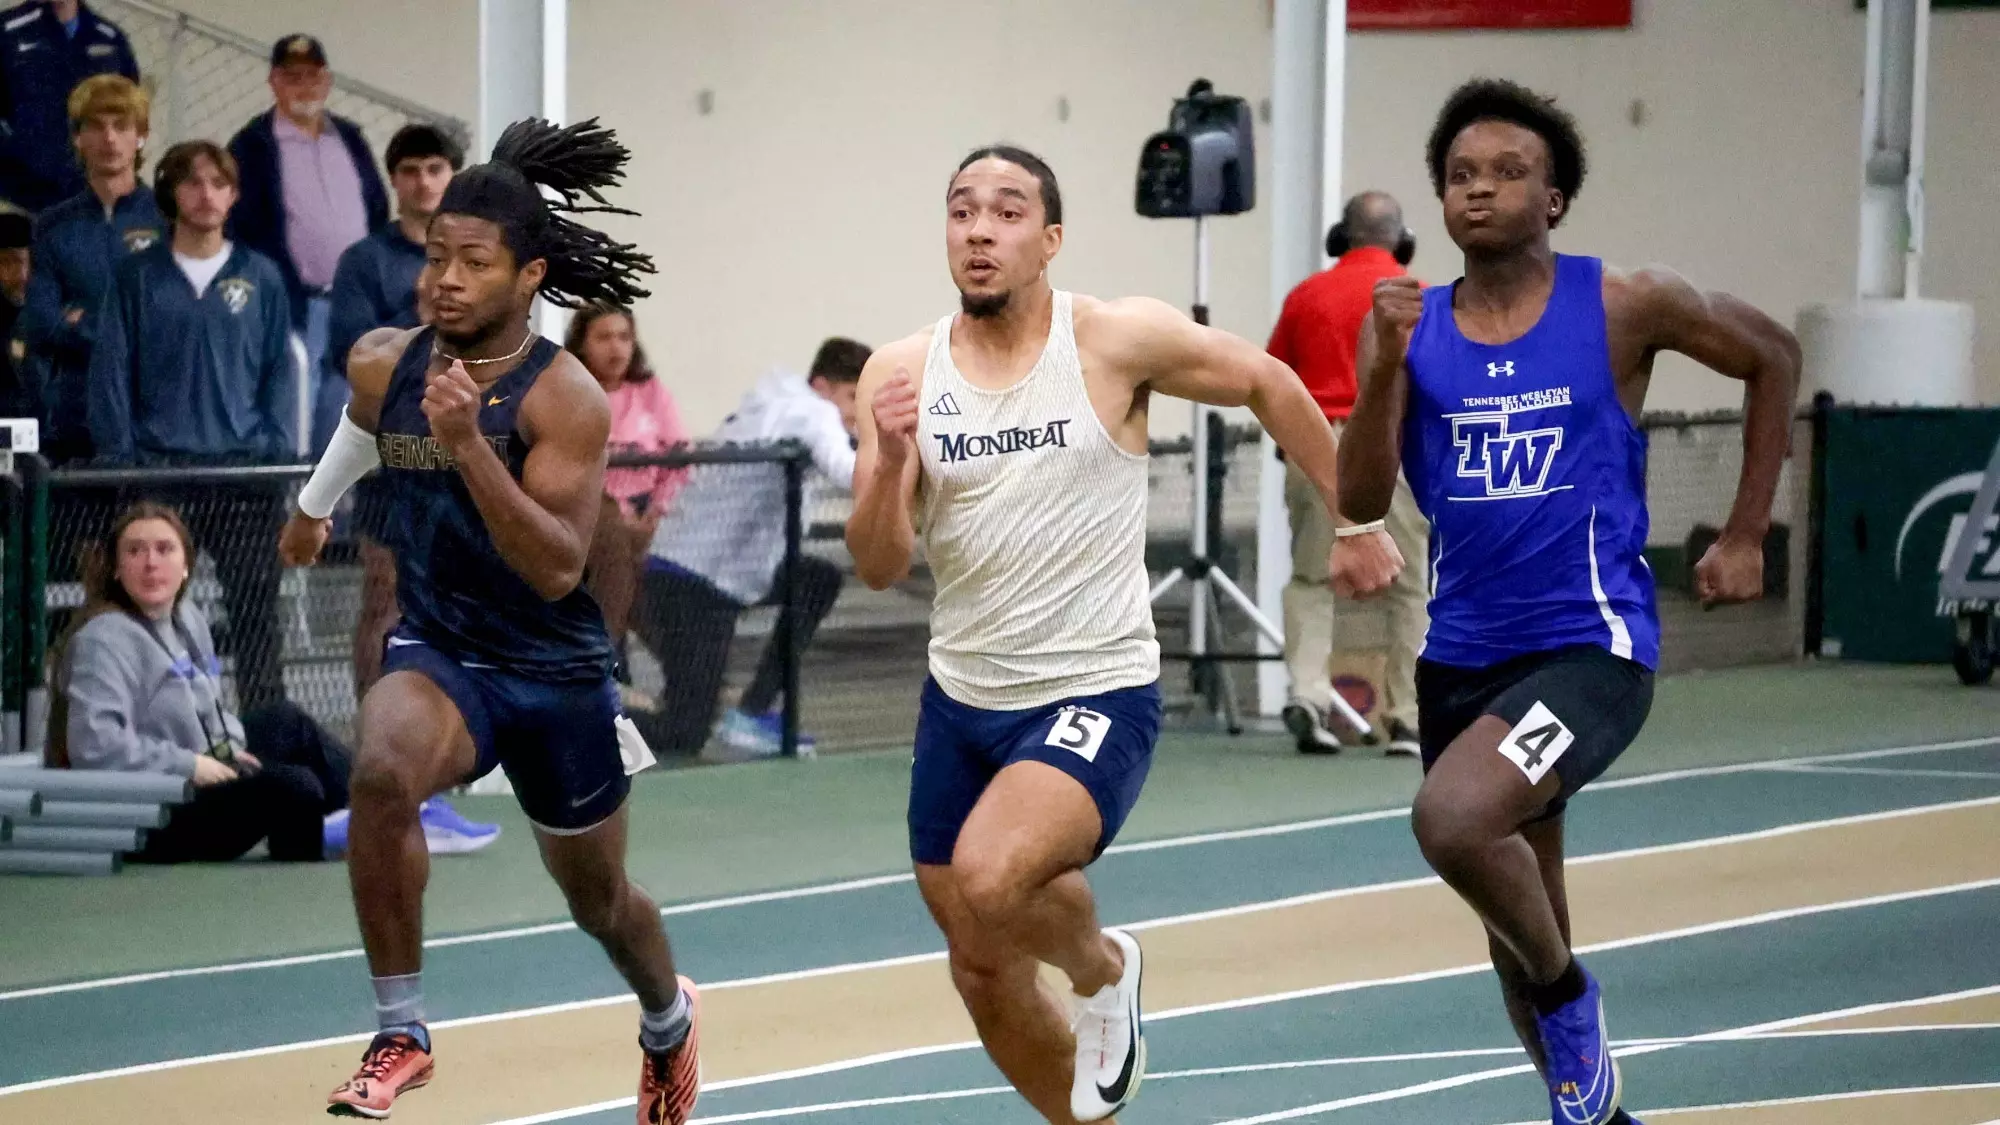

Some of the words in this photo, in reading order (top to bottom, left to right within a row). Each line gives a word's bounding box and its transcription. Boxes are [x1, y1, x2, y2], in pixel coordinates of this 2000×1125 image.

[1463, 395, 1518, 407] TENNESSEE
[1520, 386, 1570, 402] WESLEYAN
[1501, 394, 1570, 412] BULLDOGS
[1452, 414, 1563, 496] TW
[1059, 711, 1100, 748] 5
[1514, 721, 1562, 770] 4
